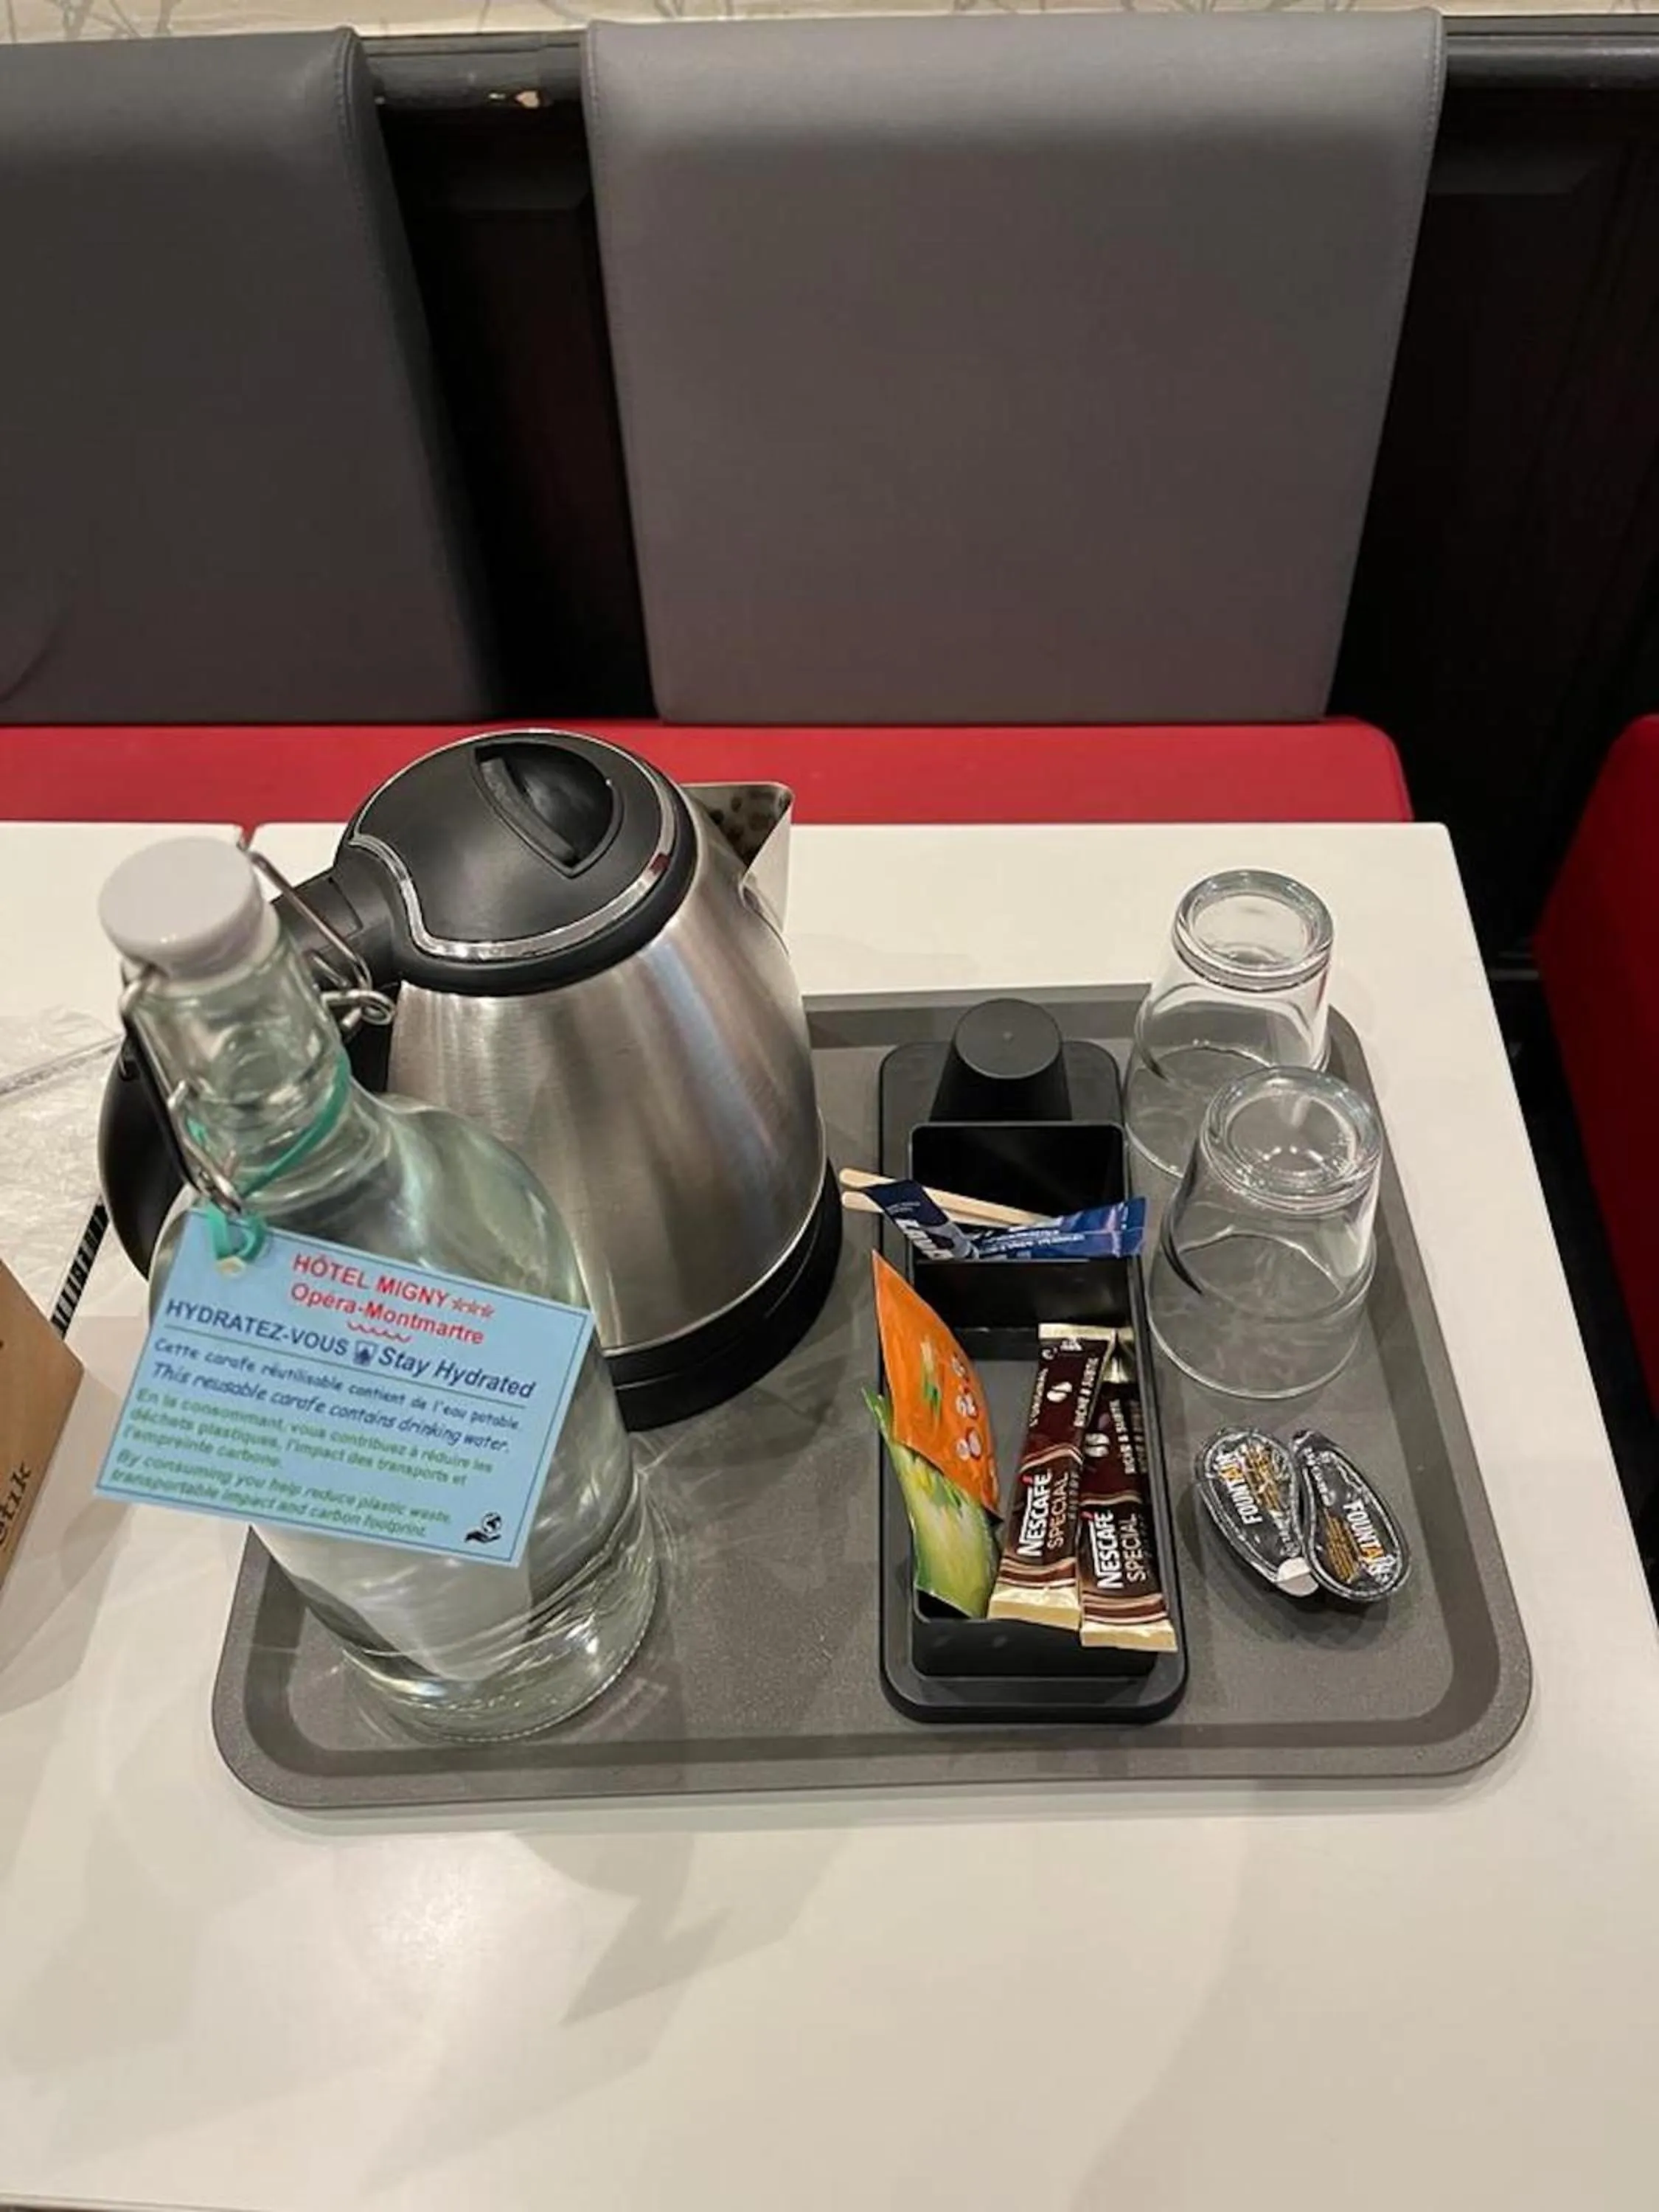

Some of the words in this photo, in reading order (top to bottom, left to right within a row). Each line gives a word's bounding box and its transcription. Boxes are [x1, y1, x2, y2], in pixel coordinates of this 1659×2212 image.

[294, 1253, 368, 1288] HÔTEL
[377, 1276, 448, 1307] MIGNY
[167, 1300, 348, 1355] HYDRATEZ-VOUS
[155, 1338, 199, 1360] Cette
[204, 1352, 255, 1372] carafe
[261, 1363, 343, 1391] réutilisable
[348, 1385, 406, 1405] contient
[411, 1397, 427, 1410] de
[378, 1346, 431, 1377] Stay
[433, 1360, 536, 1398] Hydrated
[136, 1388, 159, 1404] En
[330, 1431, 407, 1455] contribuez
[153, 1362, 191, 1383] This
[192, 1376, 267, 1400] reusable
[270, 1392, 326, 1413] carafe
[329, 1405, 397, 1428] contains
[397, 1417, 462, 1446] drinking
[464, 1435, 508, 1453] water.
[116, 1449, 142, 1467] By
[143, 1457, 233, 1485] consuming
[234, 1475, 266, 1489] you
[269, 1478, 302, 1496] help
[305, 1488, 355, 1506] reduce
[356, 1497, 406, 1514] plastic
[347, 1453, 373, 1467] des
[378, 1458, 448, 1482] transports
[277, 1502, 308, 1515] and
[310, 1508, 361, 1525] carbon
[1047, 1472, 1068, 1549] SPECIAL
[1119, 1513, 1146, 1582] SPECIAL
